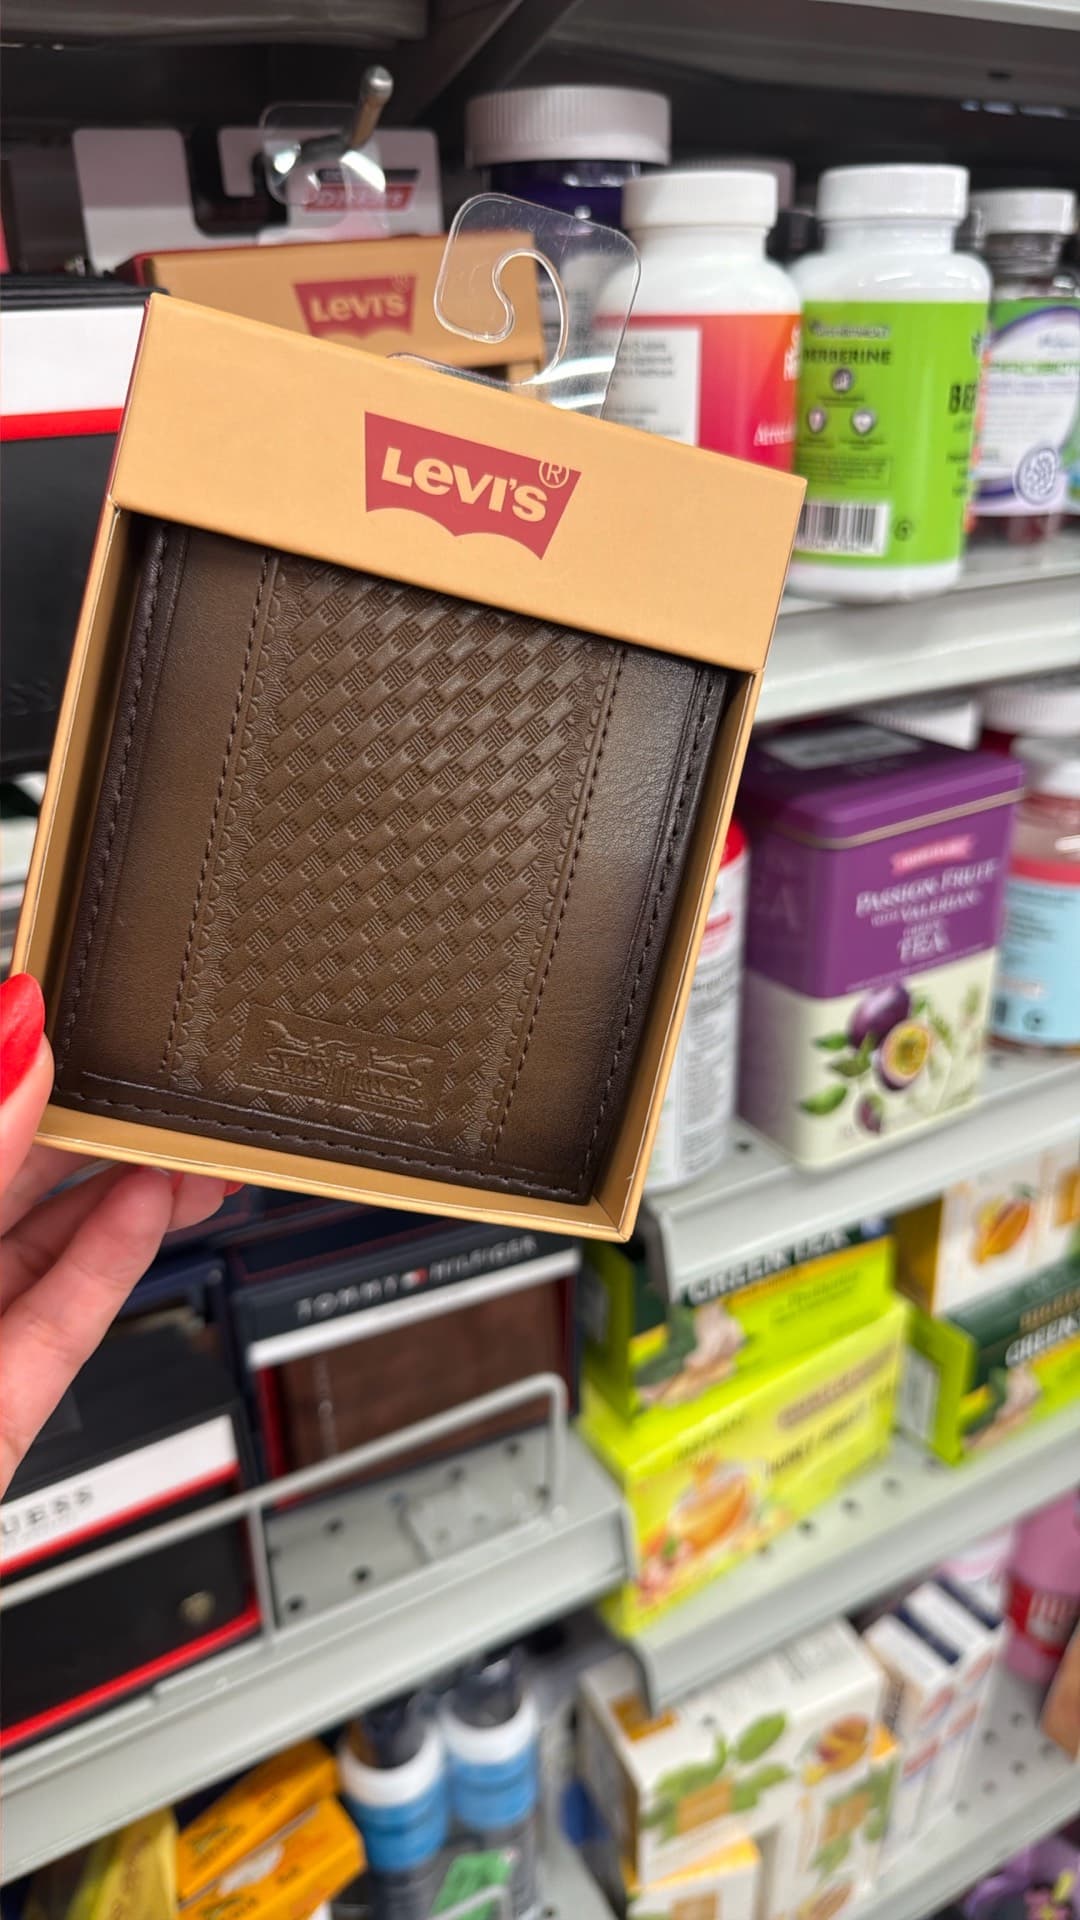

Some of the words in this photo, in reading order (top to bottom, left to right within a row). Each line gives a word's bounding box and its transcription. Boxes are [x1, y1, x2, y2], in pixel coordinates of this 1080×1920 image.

[856, 877, 940, 917] PASSION
[941, 857, 998, 890] FRUIT
[897, 931, 949, 963] TEA
[297, 1273, 398, 1323] TOMMY
[429, 1234, 537, 1281] HILFIGER
[1, 1485, 95, 1536] UESS
